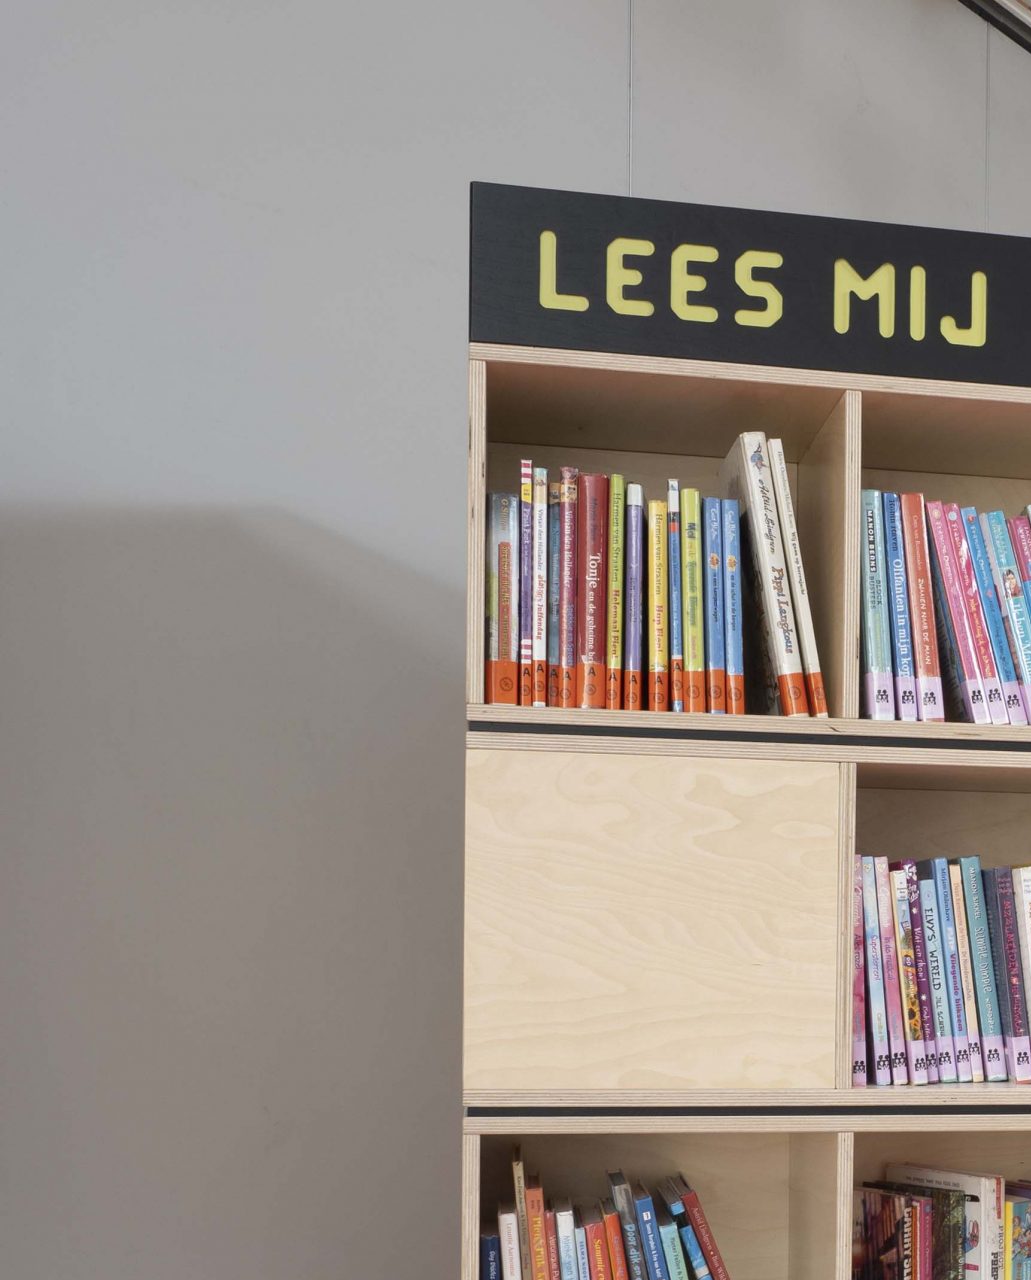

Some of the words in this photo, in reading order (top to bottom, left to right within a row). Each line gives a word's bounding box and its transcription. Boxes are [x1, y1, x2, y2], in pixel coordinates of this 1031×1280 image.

[538, 229, 784, 328] LEES
[832, 258, 988, 347] MIJ
[613, 493, 621, 529] Harmen
[655, 513, 663, 544] Harmen
[586, 552, 601, 589] Tonje
[613, 546, 621, 582] Straaten
[655, 562, 663, 596] Straaten
[589, 592, 596, 601] en
[892, 559, 908, 611] Olifanten
[918, 578, 926, 610] ZWAAIEN
[589, 603, 597, 614] de
[898, 614, 907, 625] in
[920, 611, 928, 631] NAAR
[585, 615, 597, 650] geheime
[898, 628, 912, 655] mijn
[922, 632, 929, 643] DE
[1016, 617, 1028, 639] ben
[923, 645, 932, 665] MAAN
[925, 907, 935, 941] ELVY'S
[929, 950, 941, 991] WERELD
[950, 953, 959, 996] Vliegende
[955, 998, 964, 1032] bliksem
[625, 1223, 638, 1246] Door
[594, 1239, 605, 1268] Sammie
[629, 1248, 640, 1263] dik
